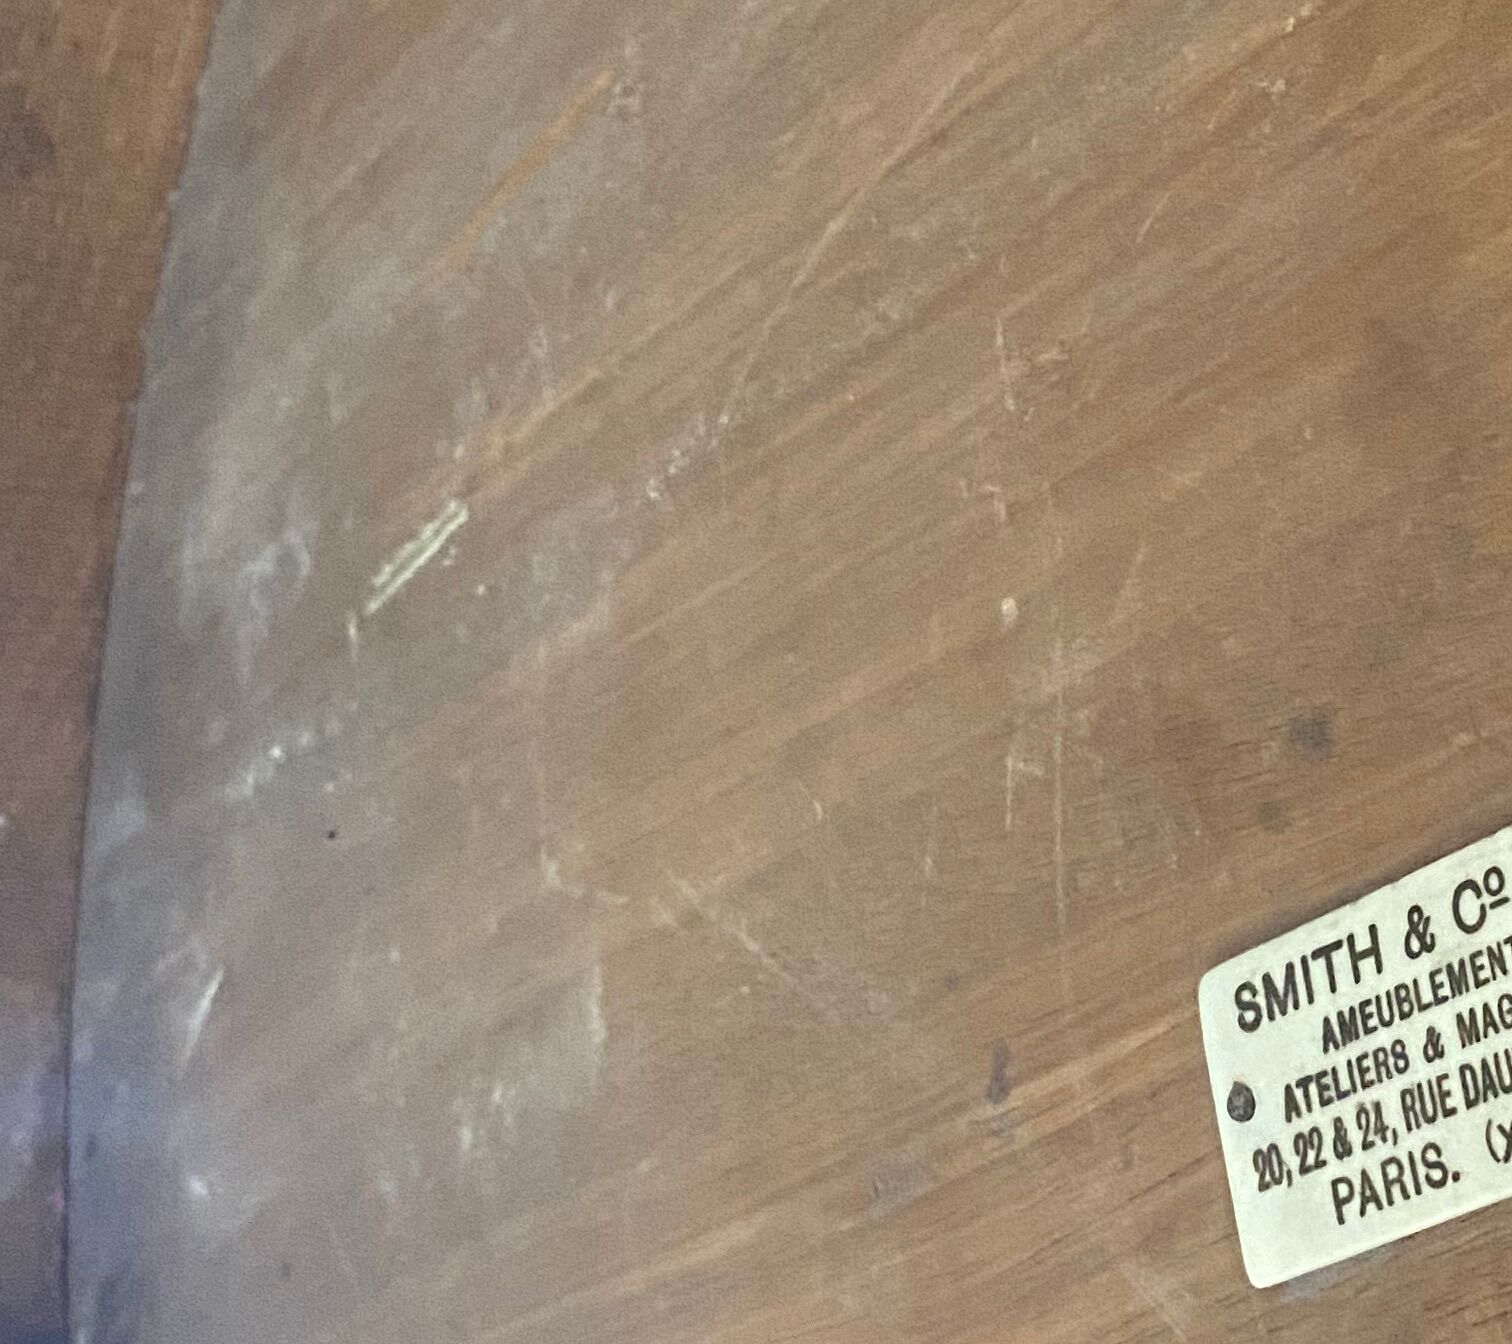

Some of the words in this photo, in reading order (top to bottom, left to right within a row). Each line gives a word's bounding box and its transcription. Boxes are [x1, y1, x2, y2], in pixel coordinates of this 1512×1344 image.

[1234, 922, 1385, 1034] SMITH
[1403, 903, 1436, 960] &
[1283, 1038, 1410, 1125] ATELIERS
[1422, 1025, 1446, 1064] &
[1252, 1141, 1294, 1193] 20,
[1293, 1124, 1328, 1177] 22
[1332, 1115, 1354, 1161] &
[1355, 1099, 1399, 1153] 24,
[1399, 1072, 1459, 1135] RUE
[1329, 1141, 1462, 1226] PARIS.
